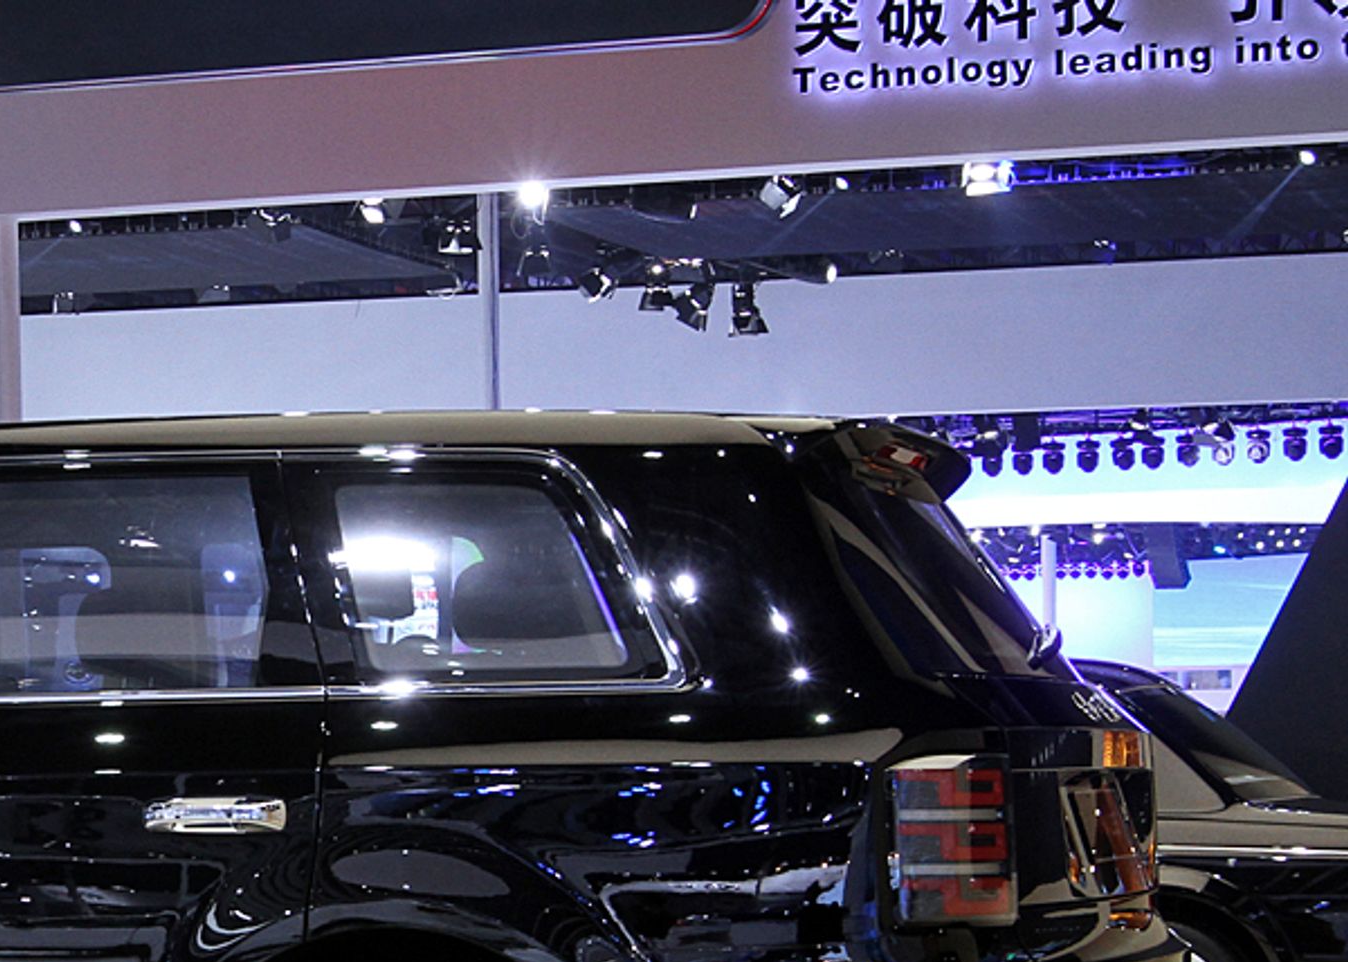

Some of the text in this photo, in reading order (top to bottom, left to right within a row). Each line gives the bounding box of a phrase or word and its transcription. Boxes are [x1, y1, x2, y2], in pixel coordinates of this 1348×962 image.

[793, 0, 1126, 56] 突破科技
[792, 57, 1034, 93] Technology
[1055, 43, 1213, 76] leading
[1235, 34, 1320, 64] into
